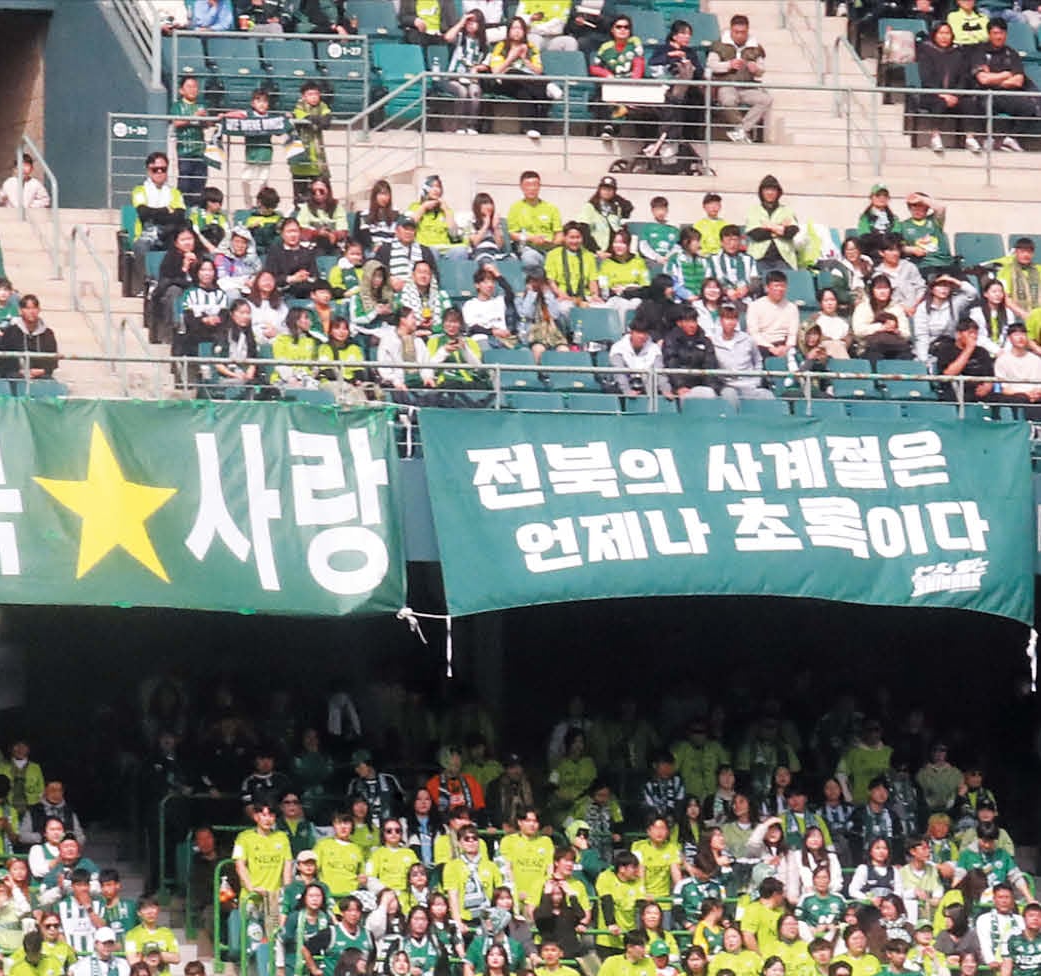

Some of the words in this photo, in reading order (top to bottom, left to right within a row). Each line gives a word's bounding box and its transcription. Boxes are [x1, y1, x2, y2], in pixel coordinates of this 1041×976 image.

[184, 422, 391, 595] 사랑
[466, 440, 684, 511] 전북의
[706, 428, 951, 493] 사계절은
[514, 505, 712, 574] 언제나
[727, 495, 991, 561] 초록이다
